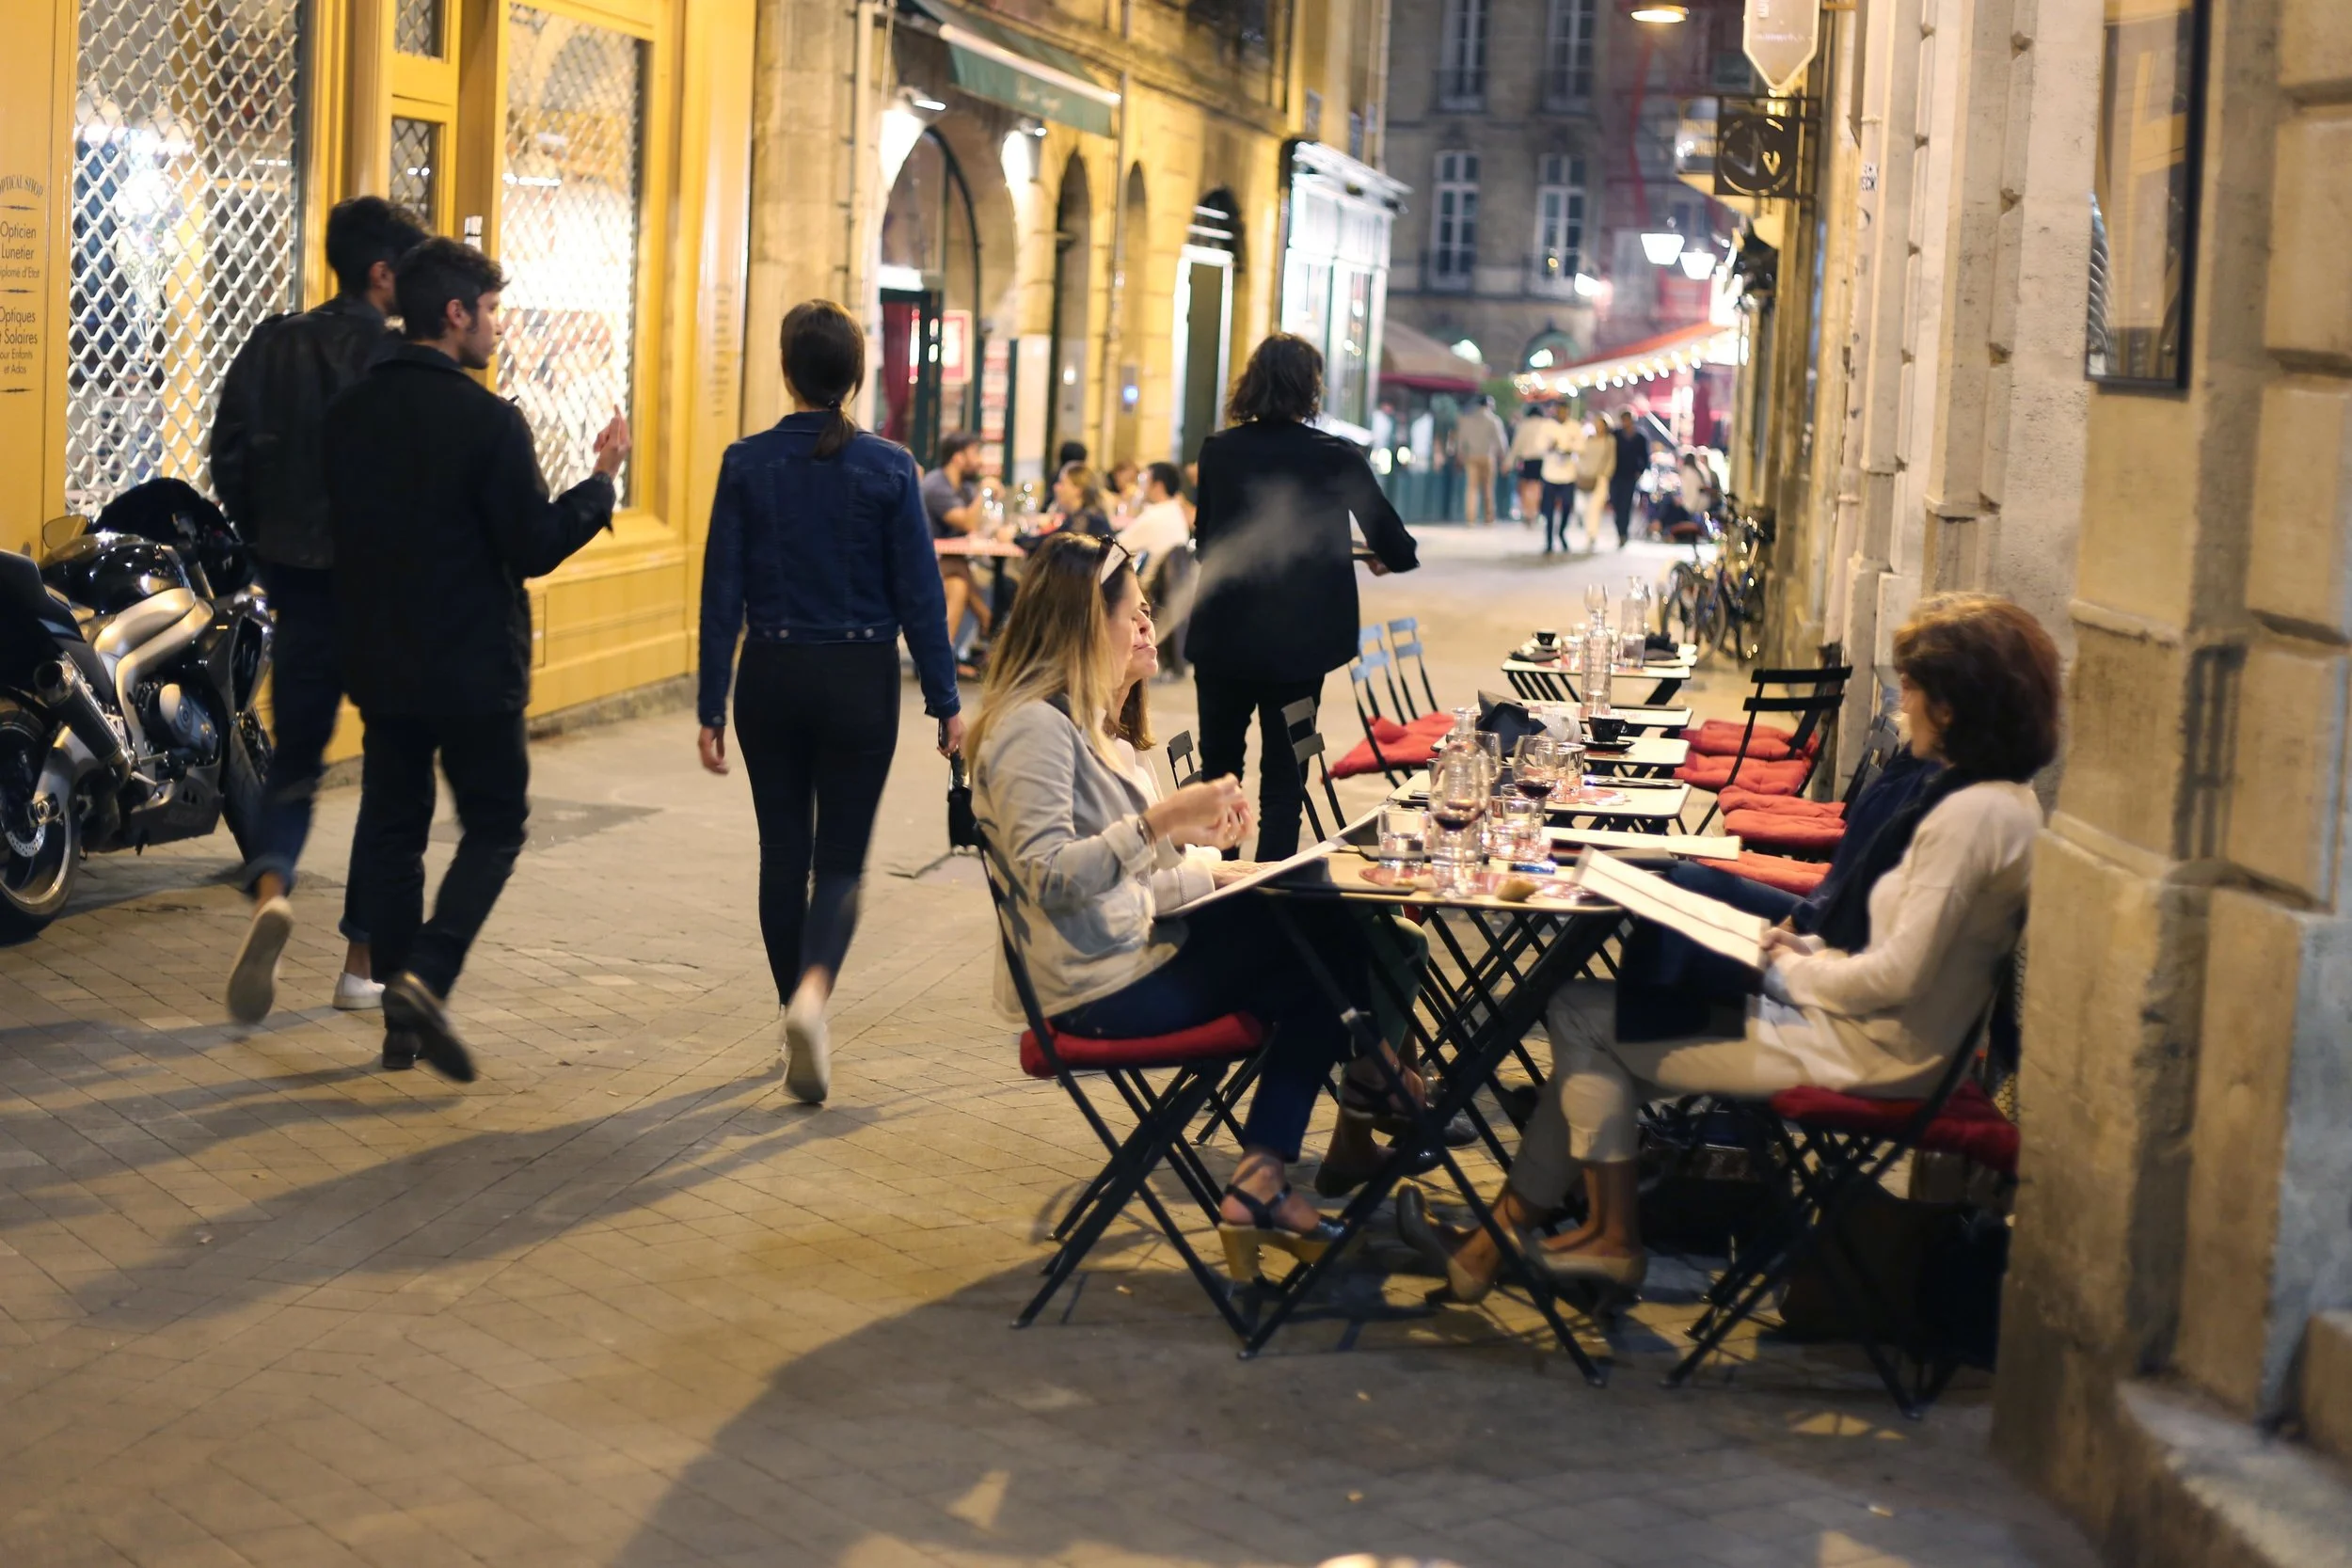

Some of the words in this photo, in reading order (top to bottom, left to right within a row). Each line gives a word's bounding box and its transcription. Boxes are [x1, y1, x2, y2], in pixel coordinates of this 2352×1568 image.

[0, 174, 23, 195] PTICAL
[24, 176, 44, 198] SHOP
[0, 221, 37, 243] Opticien
[1, 243, 35, 260] Lunetier
[5, 327, 38, 344] Solaires
[0, 351, 10, 359] our
[11, 347, 33, 359] Enfants
